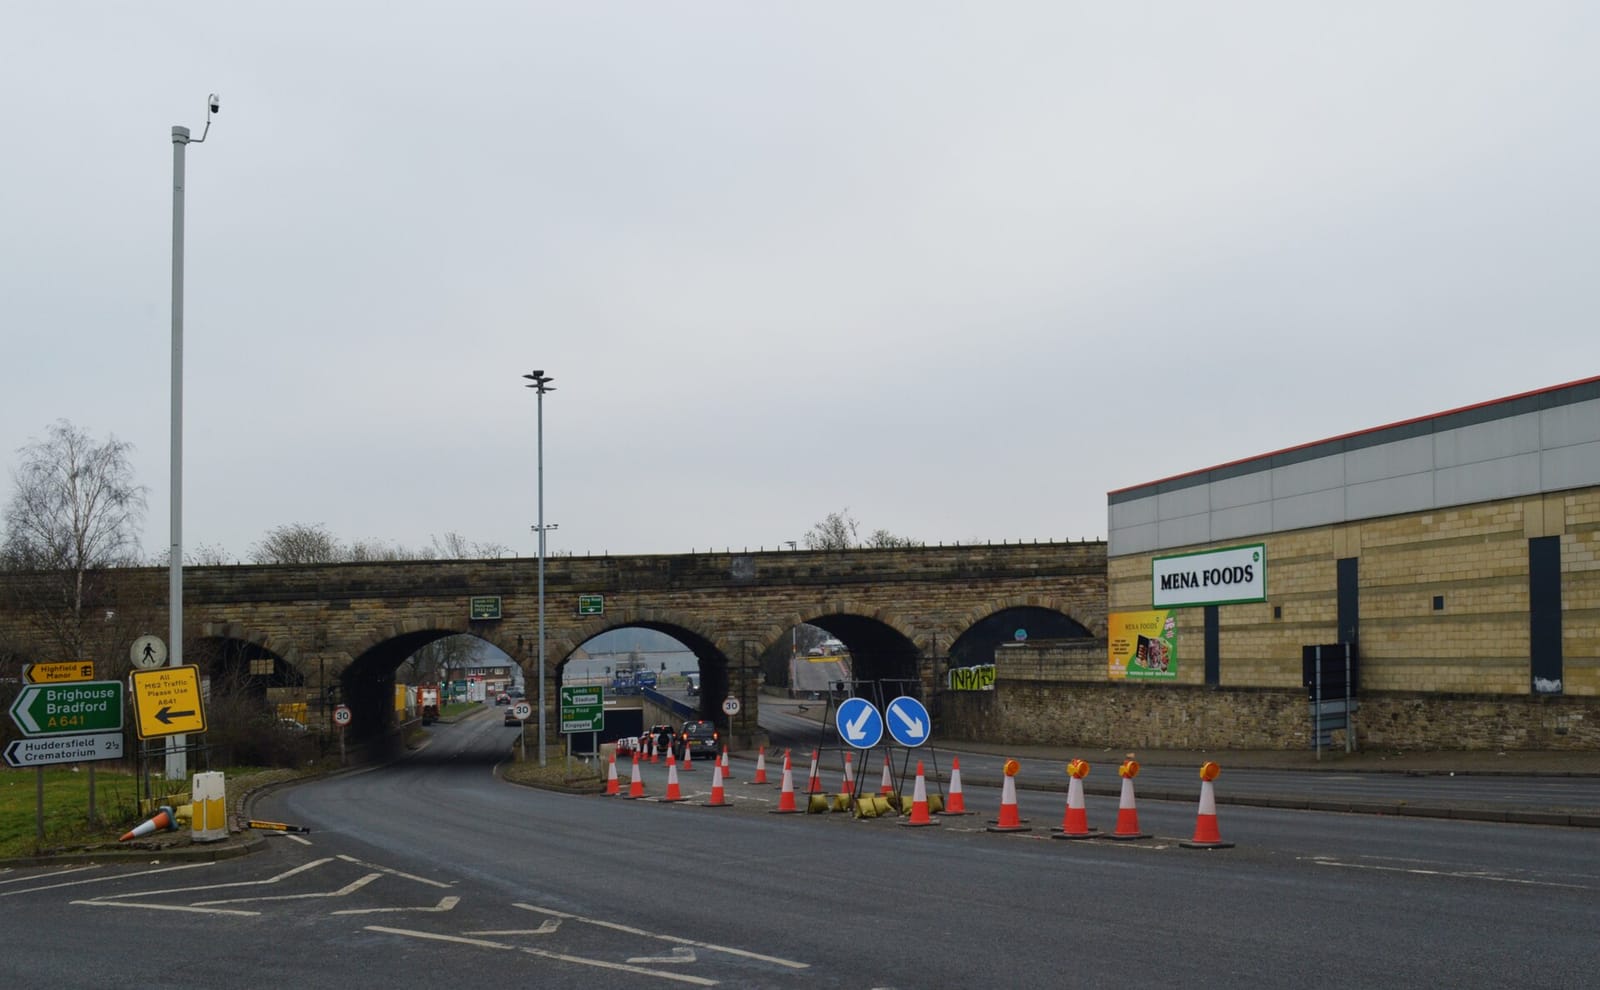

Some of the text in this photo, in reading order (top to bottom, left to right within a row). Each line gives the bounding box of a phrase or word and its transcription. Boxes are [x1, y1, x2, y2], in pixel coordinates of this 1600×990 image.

[1161, 564, 1254, 590] MENA FOODS
[1140, 622, 1157, 630] FOODS
[41, 665, 77, 673] Highfield
[164, 680, 188, 688] Traffic
[47, 688, 115, 702] Brighouse
[147, 689, 172, 697] Please
[158, 698, 177, 706] A641
[47, 701, 107, 714] Bradford
[516, 706, 529, 714] 30
[337, 712, 348, 720] 30
[48, 715, 84, 726] A 641
[25, 739, 95, 751] Huddersfield
[25, 749, 96, 761] Crematorium
